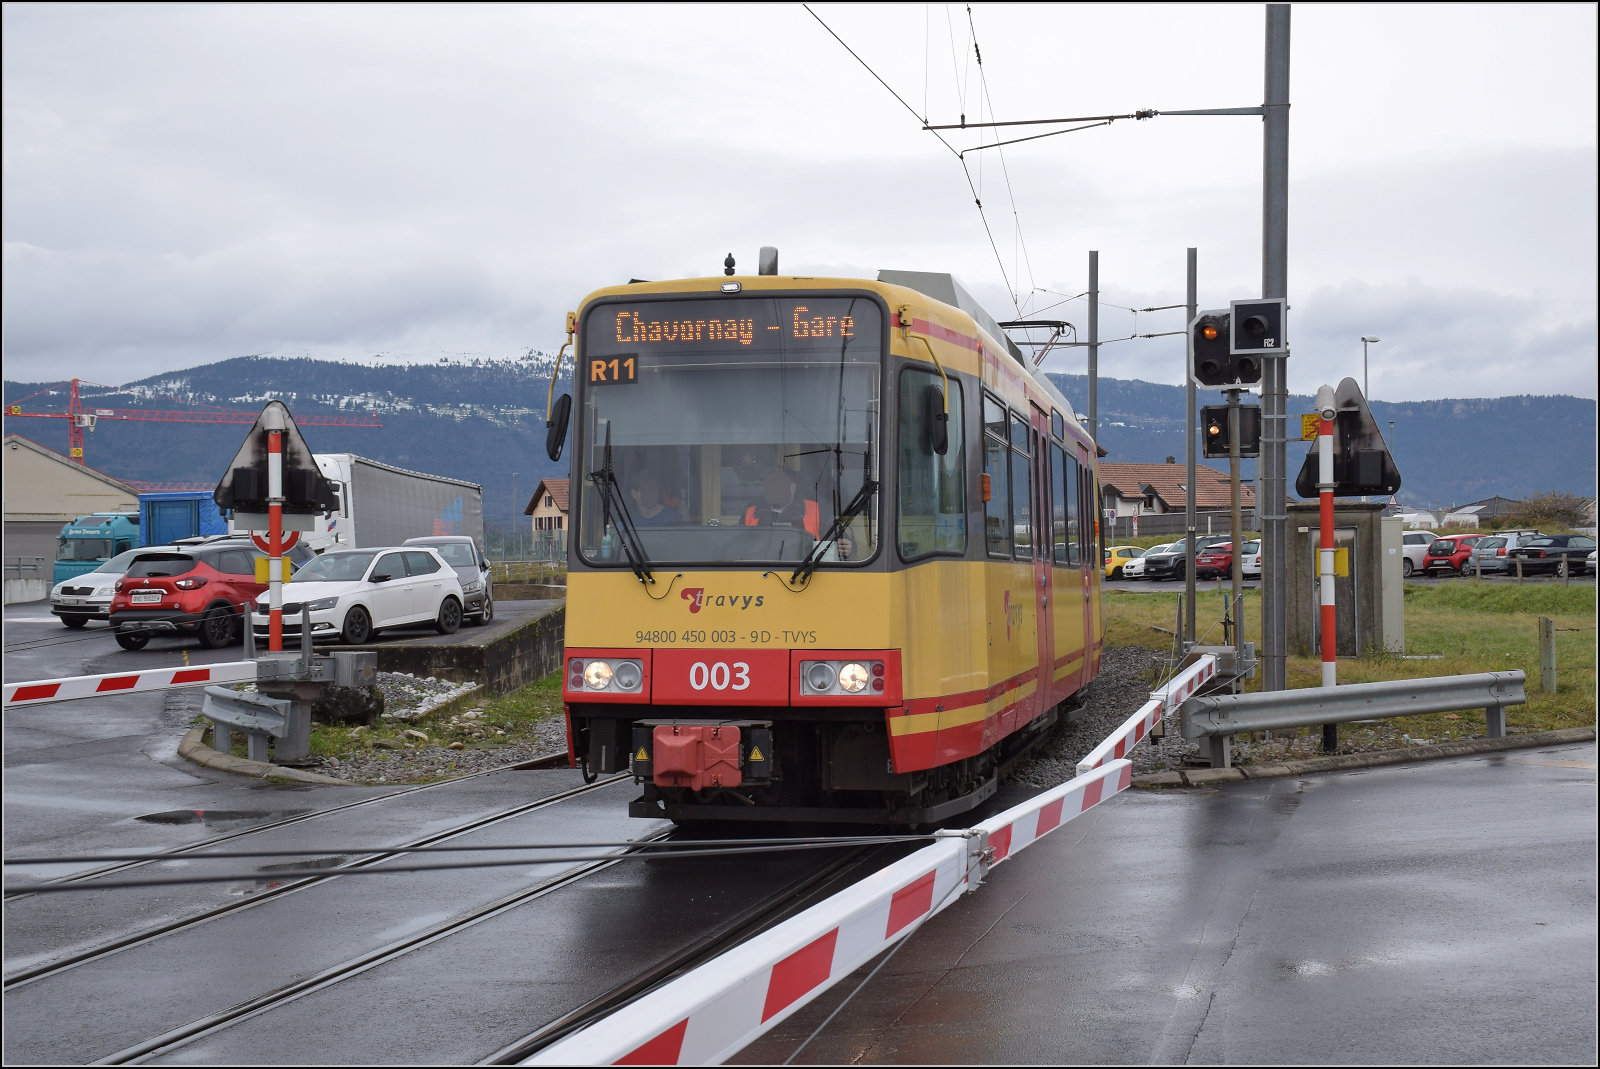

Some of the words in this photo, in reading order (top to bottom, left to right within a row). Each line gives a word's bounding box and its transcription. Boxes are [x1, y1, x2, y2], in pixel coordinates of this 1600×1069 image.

[616, 311, 752, 345] Chavornay
[793, 306, 854, 338] Gare
[1263, 338, 1275, 348] FC2
[591, 357, 635, 382] R11
[1235, 376, 1242, 385] A
[695, 590, 765, 611] travys
[635, 630, 677, 643] 94800
[681, 630, 707, 643] 450
[711, 630, 737, 643] 003
[782, 630, 818, 643] TVYS
[689, 661, 751, 691] 003
